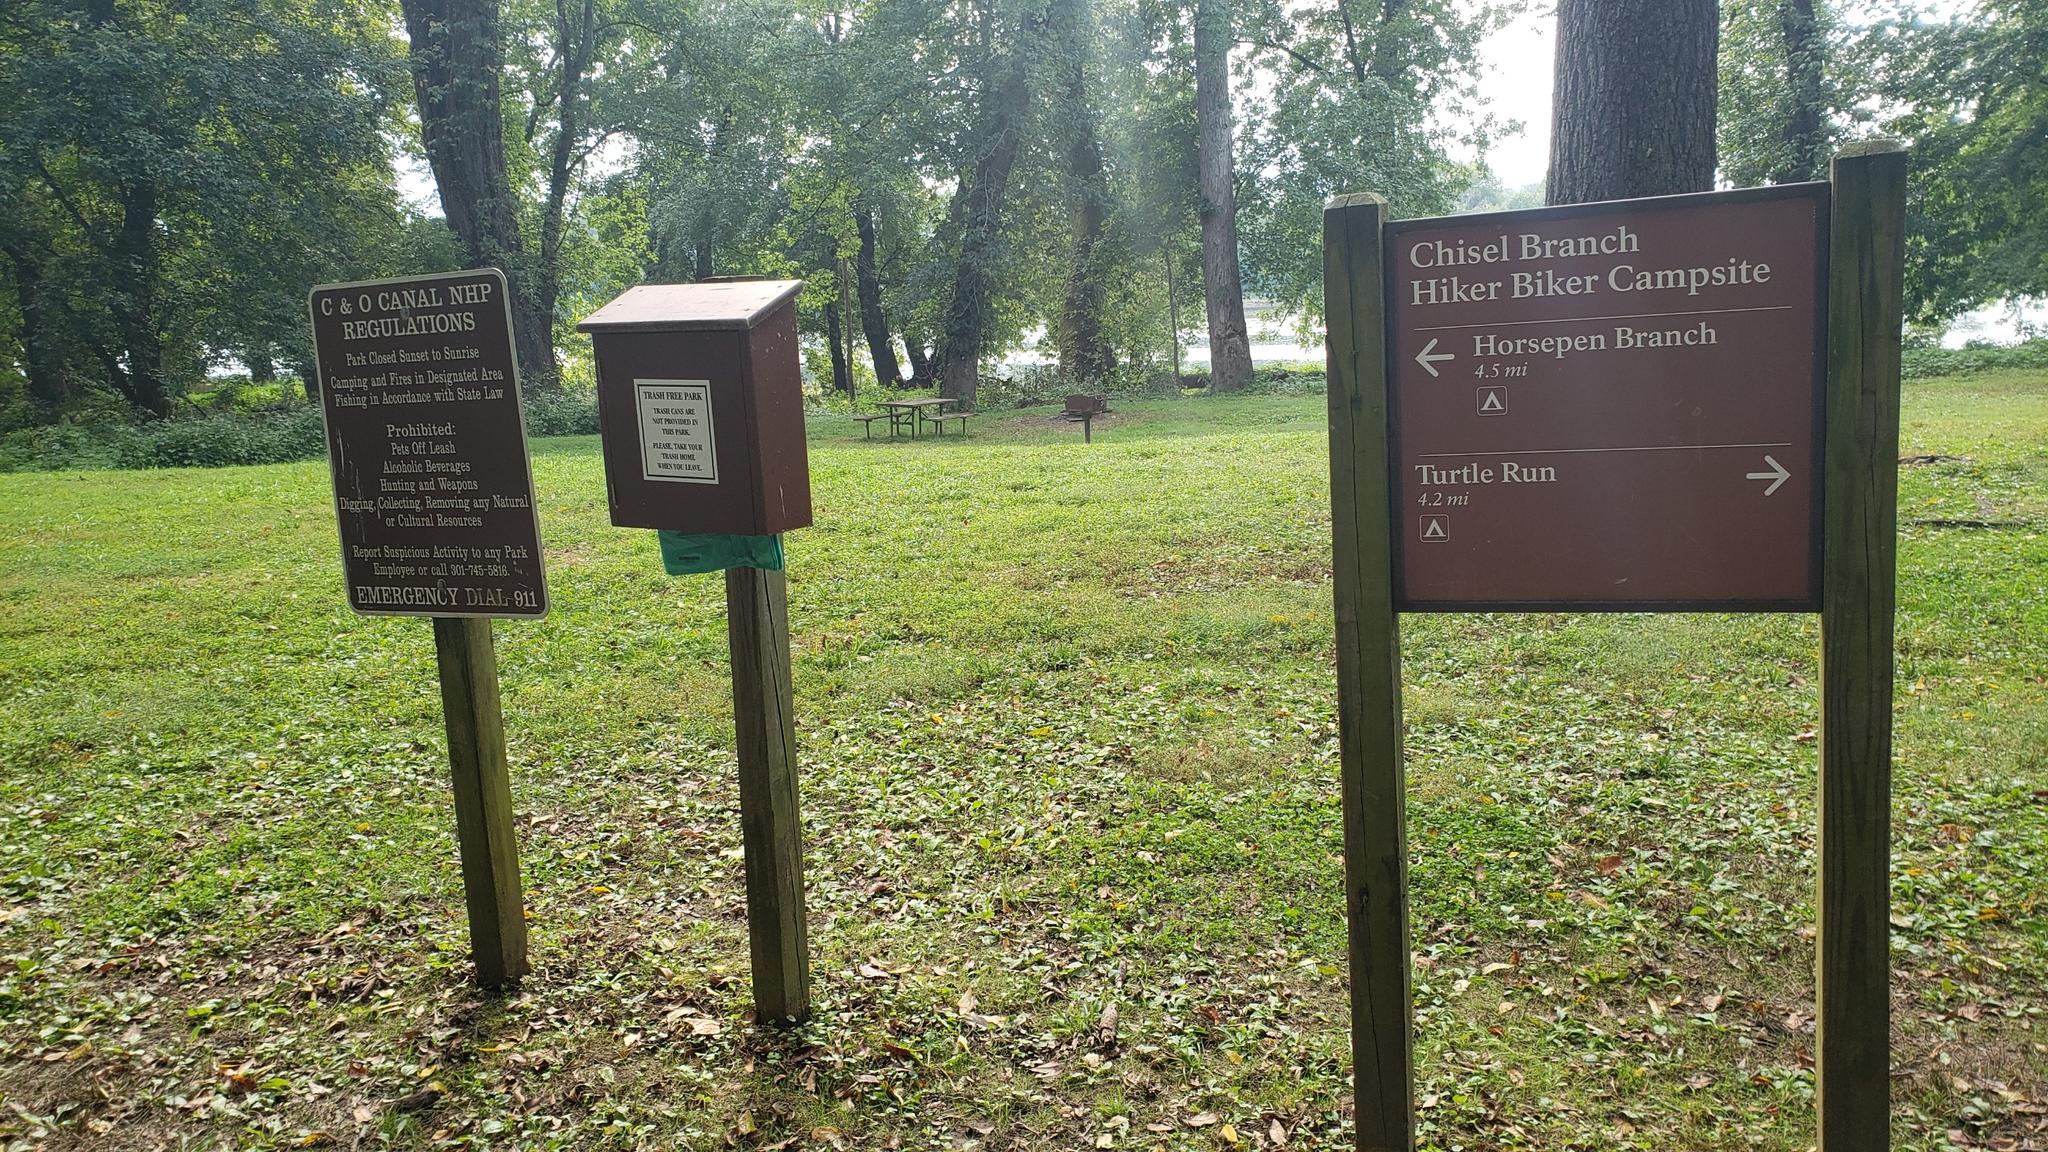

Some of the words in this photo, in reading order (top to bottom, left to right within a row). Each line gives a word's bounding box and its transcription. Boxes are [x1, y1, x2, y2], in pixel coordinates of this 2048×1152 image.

[1409, 235, 1509, 268] Chisel
[1519, 225, 1639, 260] Branch
[1411, 273, 1502, 306] Hiker
[1510, 268, 1599, 299] Biker
[1608, 258, 1771, 295] Campsite
[321, 299, 333, 315] C
[340, 298, 352, 314] &
[359, 295, 372, 312] O
[378, 288, 442, 311] CANAL
[450, 283, 492, 305] NHP
[343, 312, 475, 340] REGULATIONS
[1473, 331, 1606, 359] Horsepen
[1614, 322, 1717, 349] Branch
[346, 353, 367, 366] Park
[369, 351, 397, 364] Closed
[400, 350, 429, 363] Sunset
[432, 350, 441, 361] to
[444, 346, 479, 360] Sunrise
[1474, 363, 1500, 378] 4.5
[1504, 361, 1528, 377] mi
[330, 375, 368, 392] Camping
[371, 373, 387, 386] and
[390, 373, 412, 385] Fires
[415, 372, 424, 383] in
[427, 368, 478, 388] Designated
[481, 368, 503, 380] Area
[335, 392, 367, 409] Fishing
[370, 392, 379, 405] in
[382, 389, 431, 404] Accordance
[434, 389, 455, 401] with
[457, 388, 481, 400] State
[485, 386, 503, 399] Law
[643, 392, 664, 400] TRASH
[666, 392, 683, 400] FREE
[684, 392, 702, 400] PARK
[386, 423, 456, 437] Prohibited:
[391, 443, 409, 456] Pets
[412, 442, 426, 454] Off
[429, 441, 456, 454] Leash
[383, 460, 423, 474] Alcoholic
[426, 460, 470, 475] Beverages
[1415, 461, 1494, 486] Turtle
[1501, 462, 1556, 484] Run
[380, 479, 416, 494] Hunting
[419, 477, 435, 490] and
[437, 478, 478, 493] Weapons
[426, 496, 470, 511] Removing
[473, 499, 490, 511] any
[493, 495, 529, 508] Natural
[1418, 492, 1442, 507] 4.2
[1447, 492, 1469, 506] mi
[386, 518, 395, 527] or
[398, 514, 434, 527] Cultural
[437, 514, 482, 527] Resources
[353, 546, 381, 561] Report
[384, 546, 430, 560] Suspicious
[433, 546, 468, 560] Activity
[472, 547, 481, 558] to
[485, 549, 501, 561] any
[504, 546, 528, 558] Park
[374, 563, 415, 578] Employee
[418, 566, 428, 575] or
[431, 563, 448, 575] call
[356, 586, 458, 605] EMERGENCY
[465, 588, 508, 606] DIAL
[514, 591, 537, 607] 911
